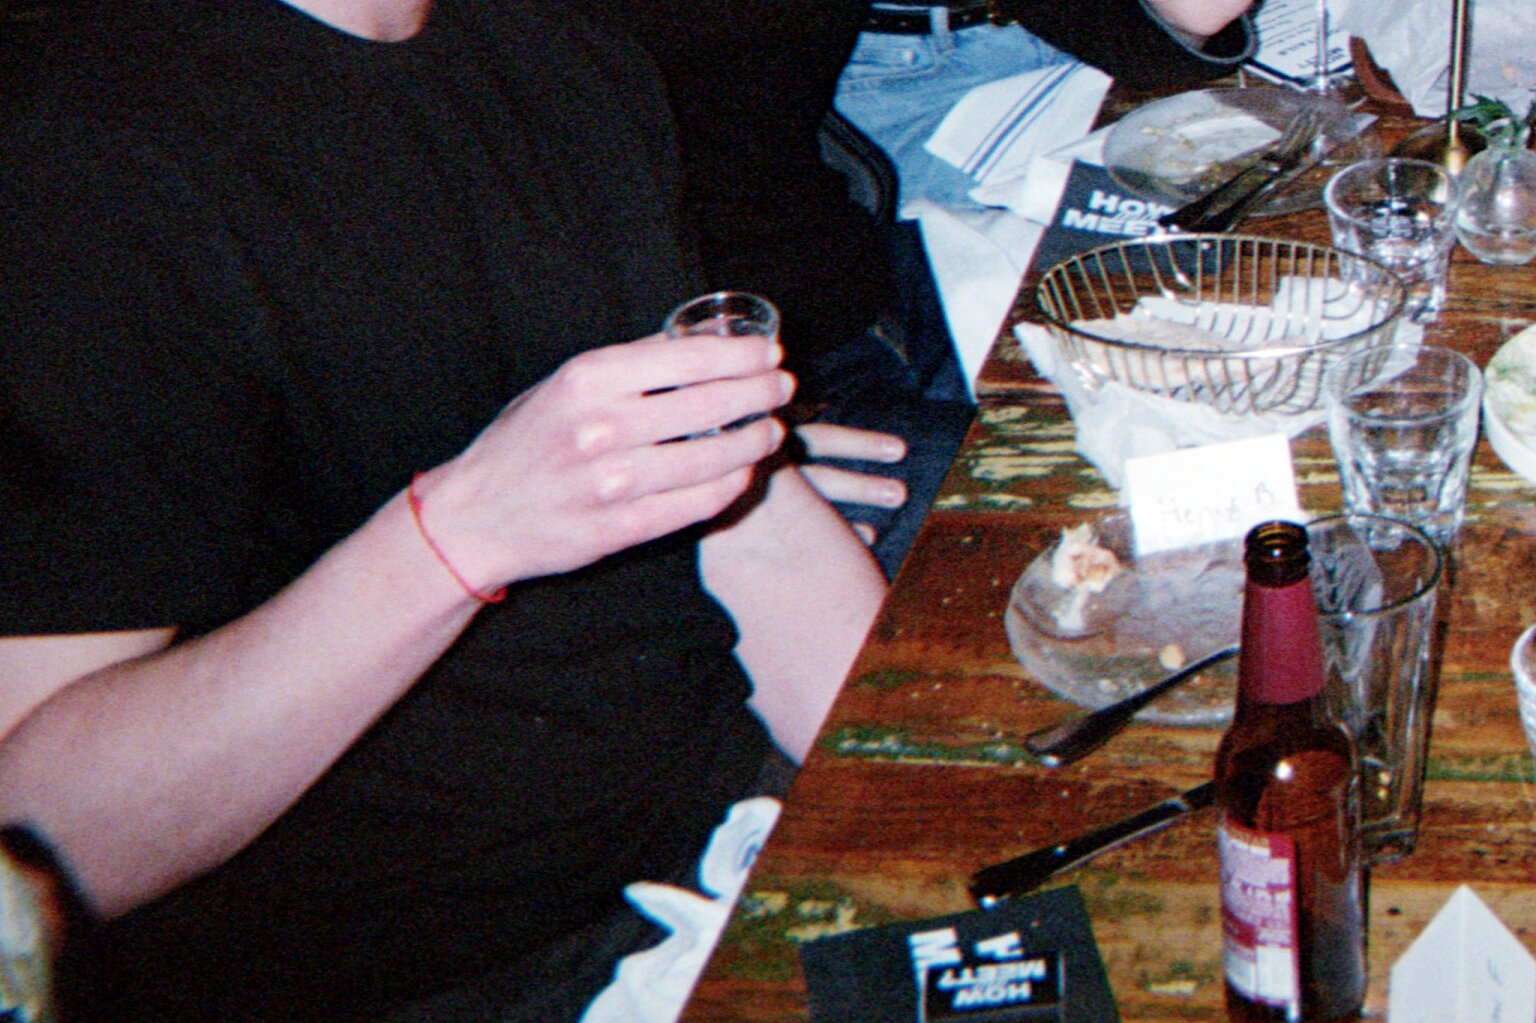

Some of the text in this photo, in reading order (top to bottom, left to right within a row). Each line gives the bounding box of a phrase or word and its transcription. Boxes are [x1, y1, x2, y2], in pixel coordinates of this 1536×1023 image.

[1089, 190, 1176, 219] HOW
[936, 958, 1047, 991] MEET?
[952, 981, 1033, 1011] HOW
